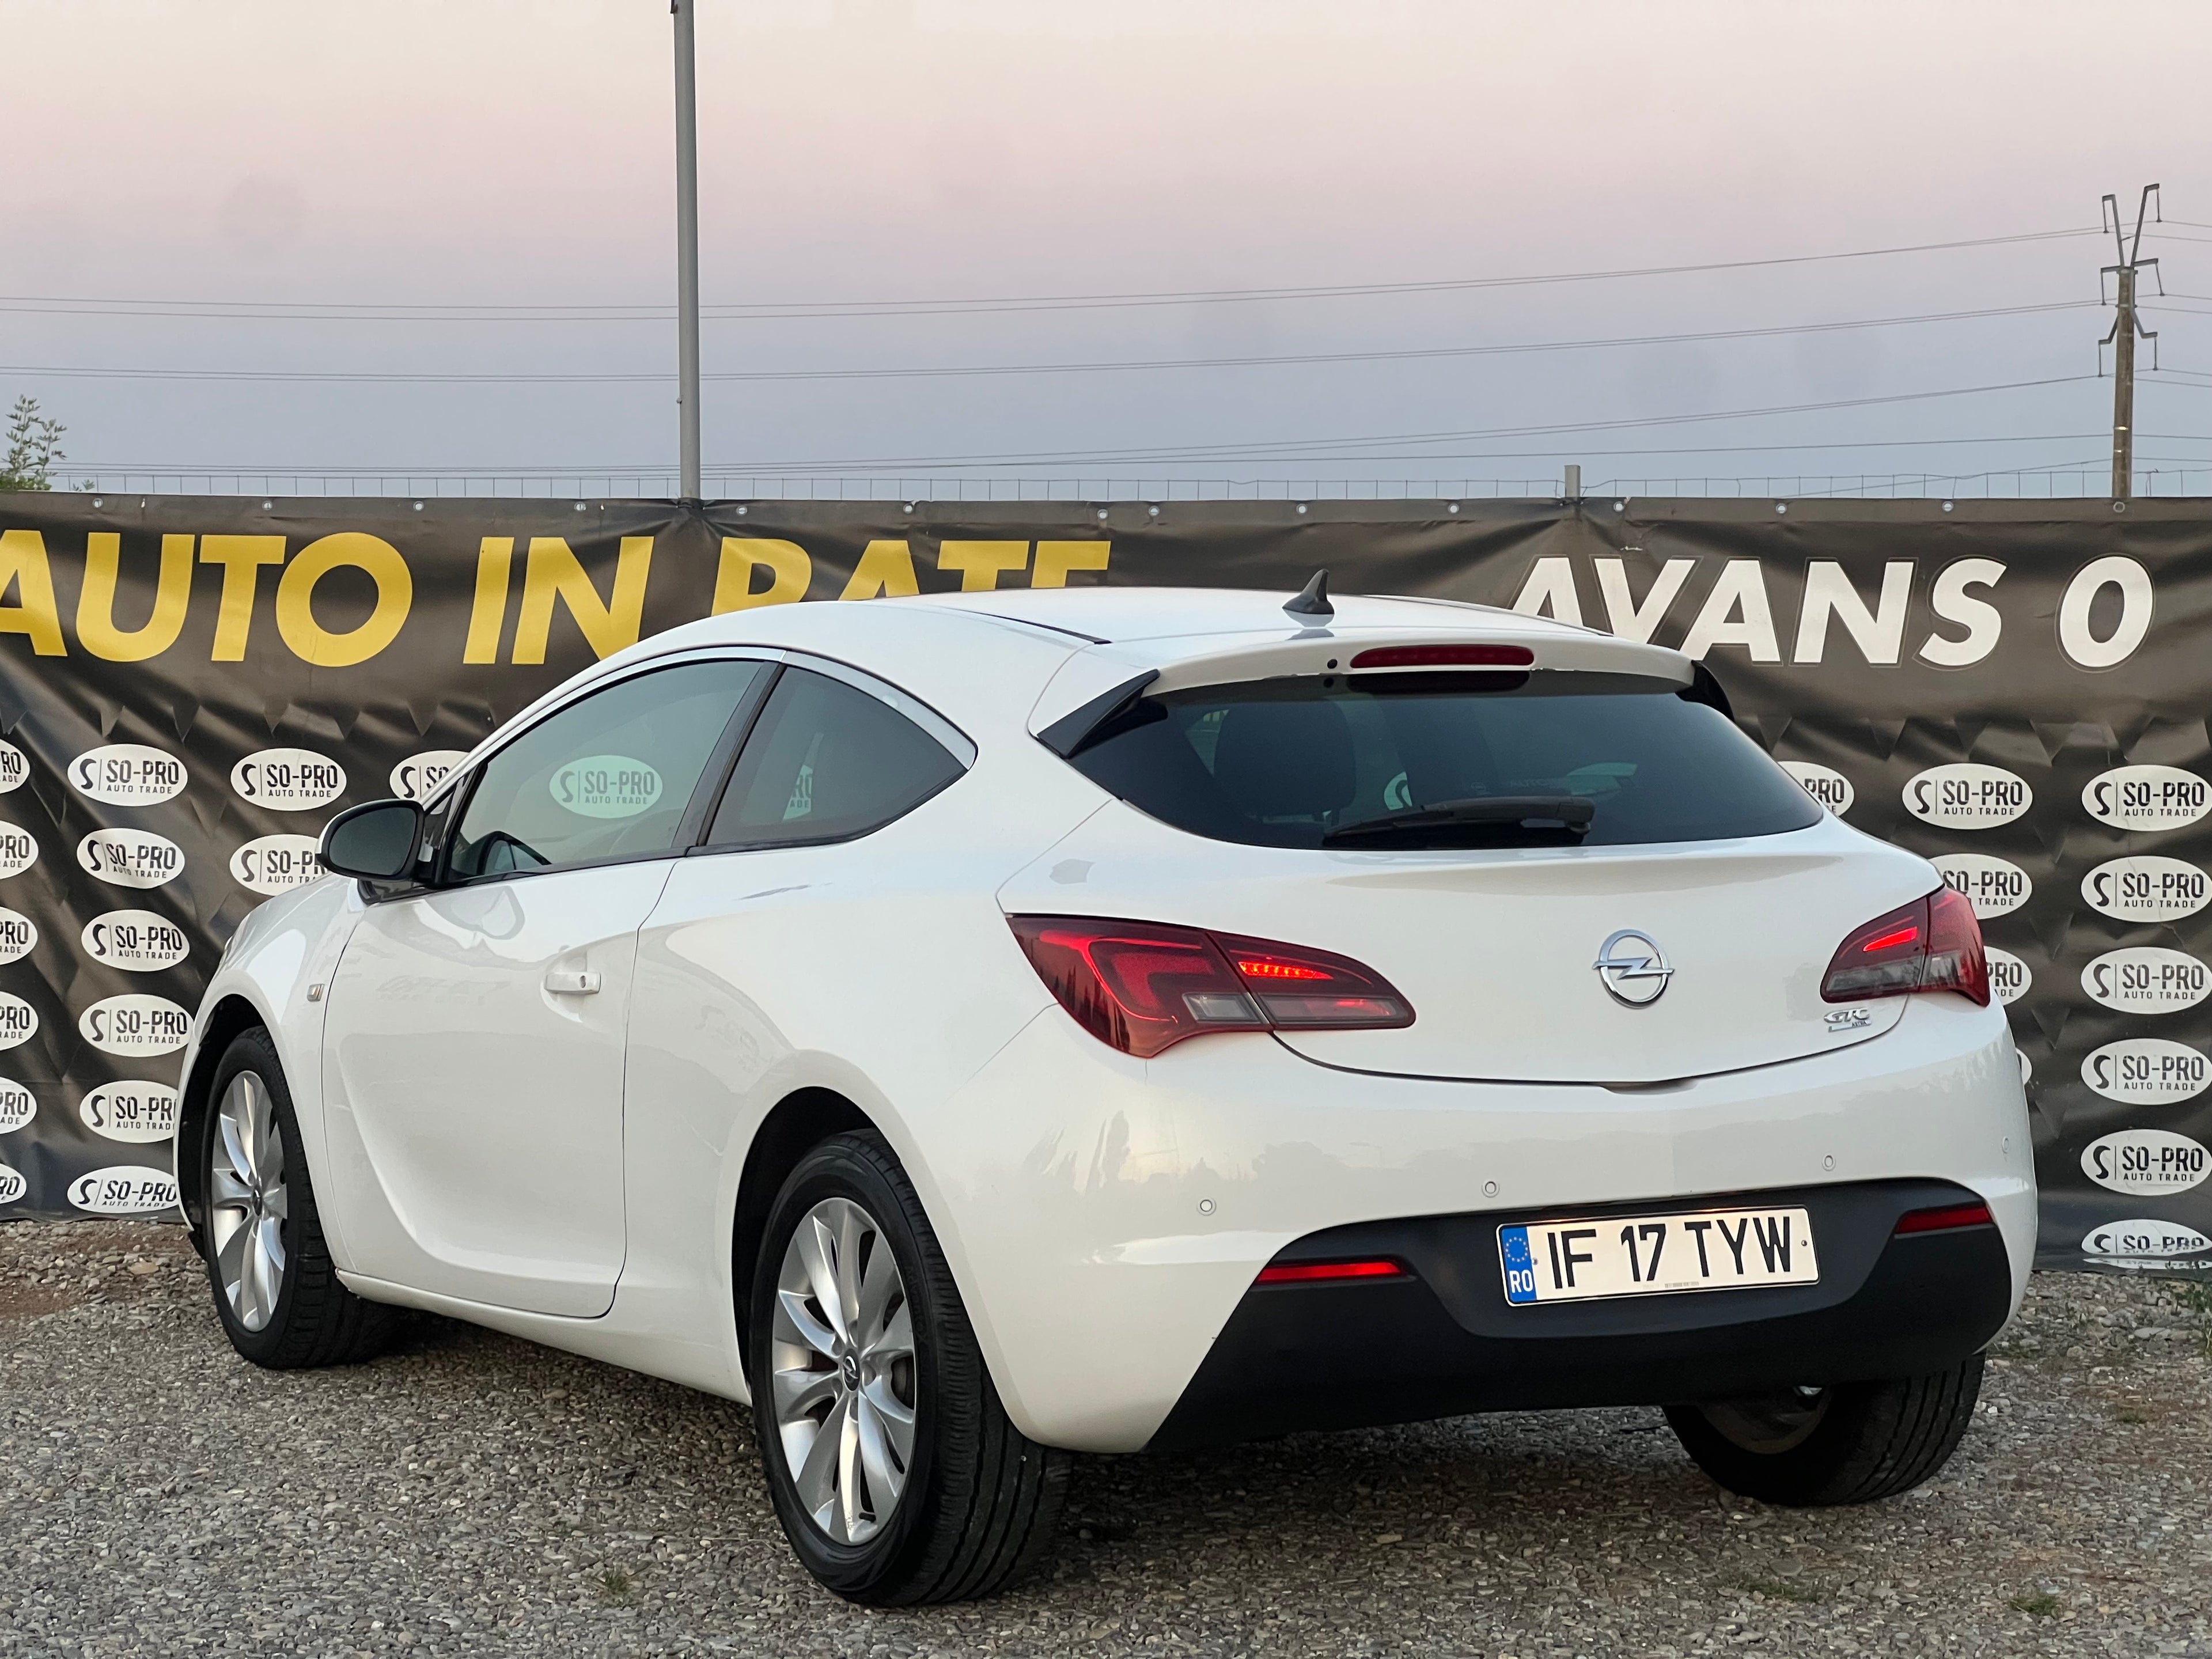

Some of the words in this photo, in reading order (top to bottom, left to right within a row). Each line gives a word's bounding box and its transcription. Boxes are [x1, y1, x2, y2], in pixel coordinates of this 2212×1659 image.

[0, 530, 413, 668] AUTO
[463, 536, 655, 665] IN
[1511, 556, 2008, 666] AVANS
[106, 759, 180, 785] SO-PRO
[266, 764, 338, 789] SO-PRO
[584, 770, 655, 796] SO-PRO
[106, 784, 134, 793] AUTO
[139, 785, 172, 794] TRADE
[268, 789, 294, 797] AUTO
[299, 789, 331, 798] TRADE
[585, 795, 611, 804] AUTO
[616, 796, 647, 805] TRADE
[1942, 780, 2023, 806] SO-PRO
[2123, 782, 2205, 807] SO-PRO
[1944, 807, 1972, 815] AUTO
[1979, 807, 2014, 816] TRADE
[2124, 808, 2153, 817] AUTO
[2160, 808, 2196, 817] TRADE
[105, 843, 176, 871] SO-PRO
[113, 865, 132, 876] AUTO
[134, 869, 167, 878] TRADE
[267, 875, 293, 884] AUTO
[1942, 870, 2022, 896] SO-PRO
[2122, 872, 2204, 899] SO-PRO
[1978, 897, 2014, 906] TRADE
[2124, 899, 2153, 908] AUTO
[2159, 900, 2195, 908] TRADE
[115, 925, 183, 951] SO-PRO
[118, 949, 141, 959] AUTO
[145, 951, 177, 960] TRADE
[2122, 964, 2204, 990] SO-PRO
[2124, 991, 2153, 999] AUTO
[2159, 991, 2196, 1000] TRADE
[116, 1009, 188, 1035] SO-PRO
[1824, 1008, 1870, 1023] GTC
[116, 1035, 143, 1043] AUTO
[148, 1036, 181, 1044] TRADE
[2122, 1055, 2204, 1081] SO-PRO
[2124, 1082, 2153, 1090] AUTO
[2159, 1082, 2196, 1091] TRADE
[115, 1096, 177, 1121] SO-PR
[116, 1121, 141, 1129] AUTO
[146, 1122, 175, 1130] TRAD
[2122, 1144, 2205, 1172] SO-PRO
[2123, 1172, 2152, 1181] AUTO
[2158, 1173, 2195, 1182] TRADE
[104, 1180, 177, 1202] SO-PRO
[1547, 1228, 1597, 1289] IF
[1620, 1223, 1666, 1282] 17
[1684, 1215, 1791, 1278] TYW
[2123, 1234, 2205, 1250] SO-PRO
[1509, 1269, 1534, 1293] RO
